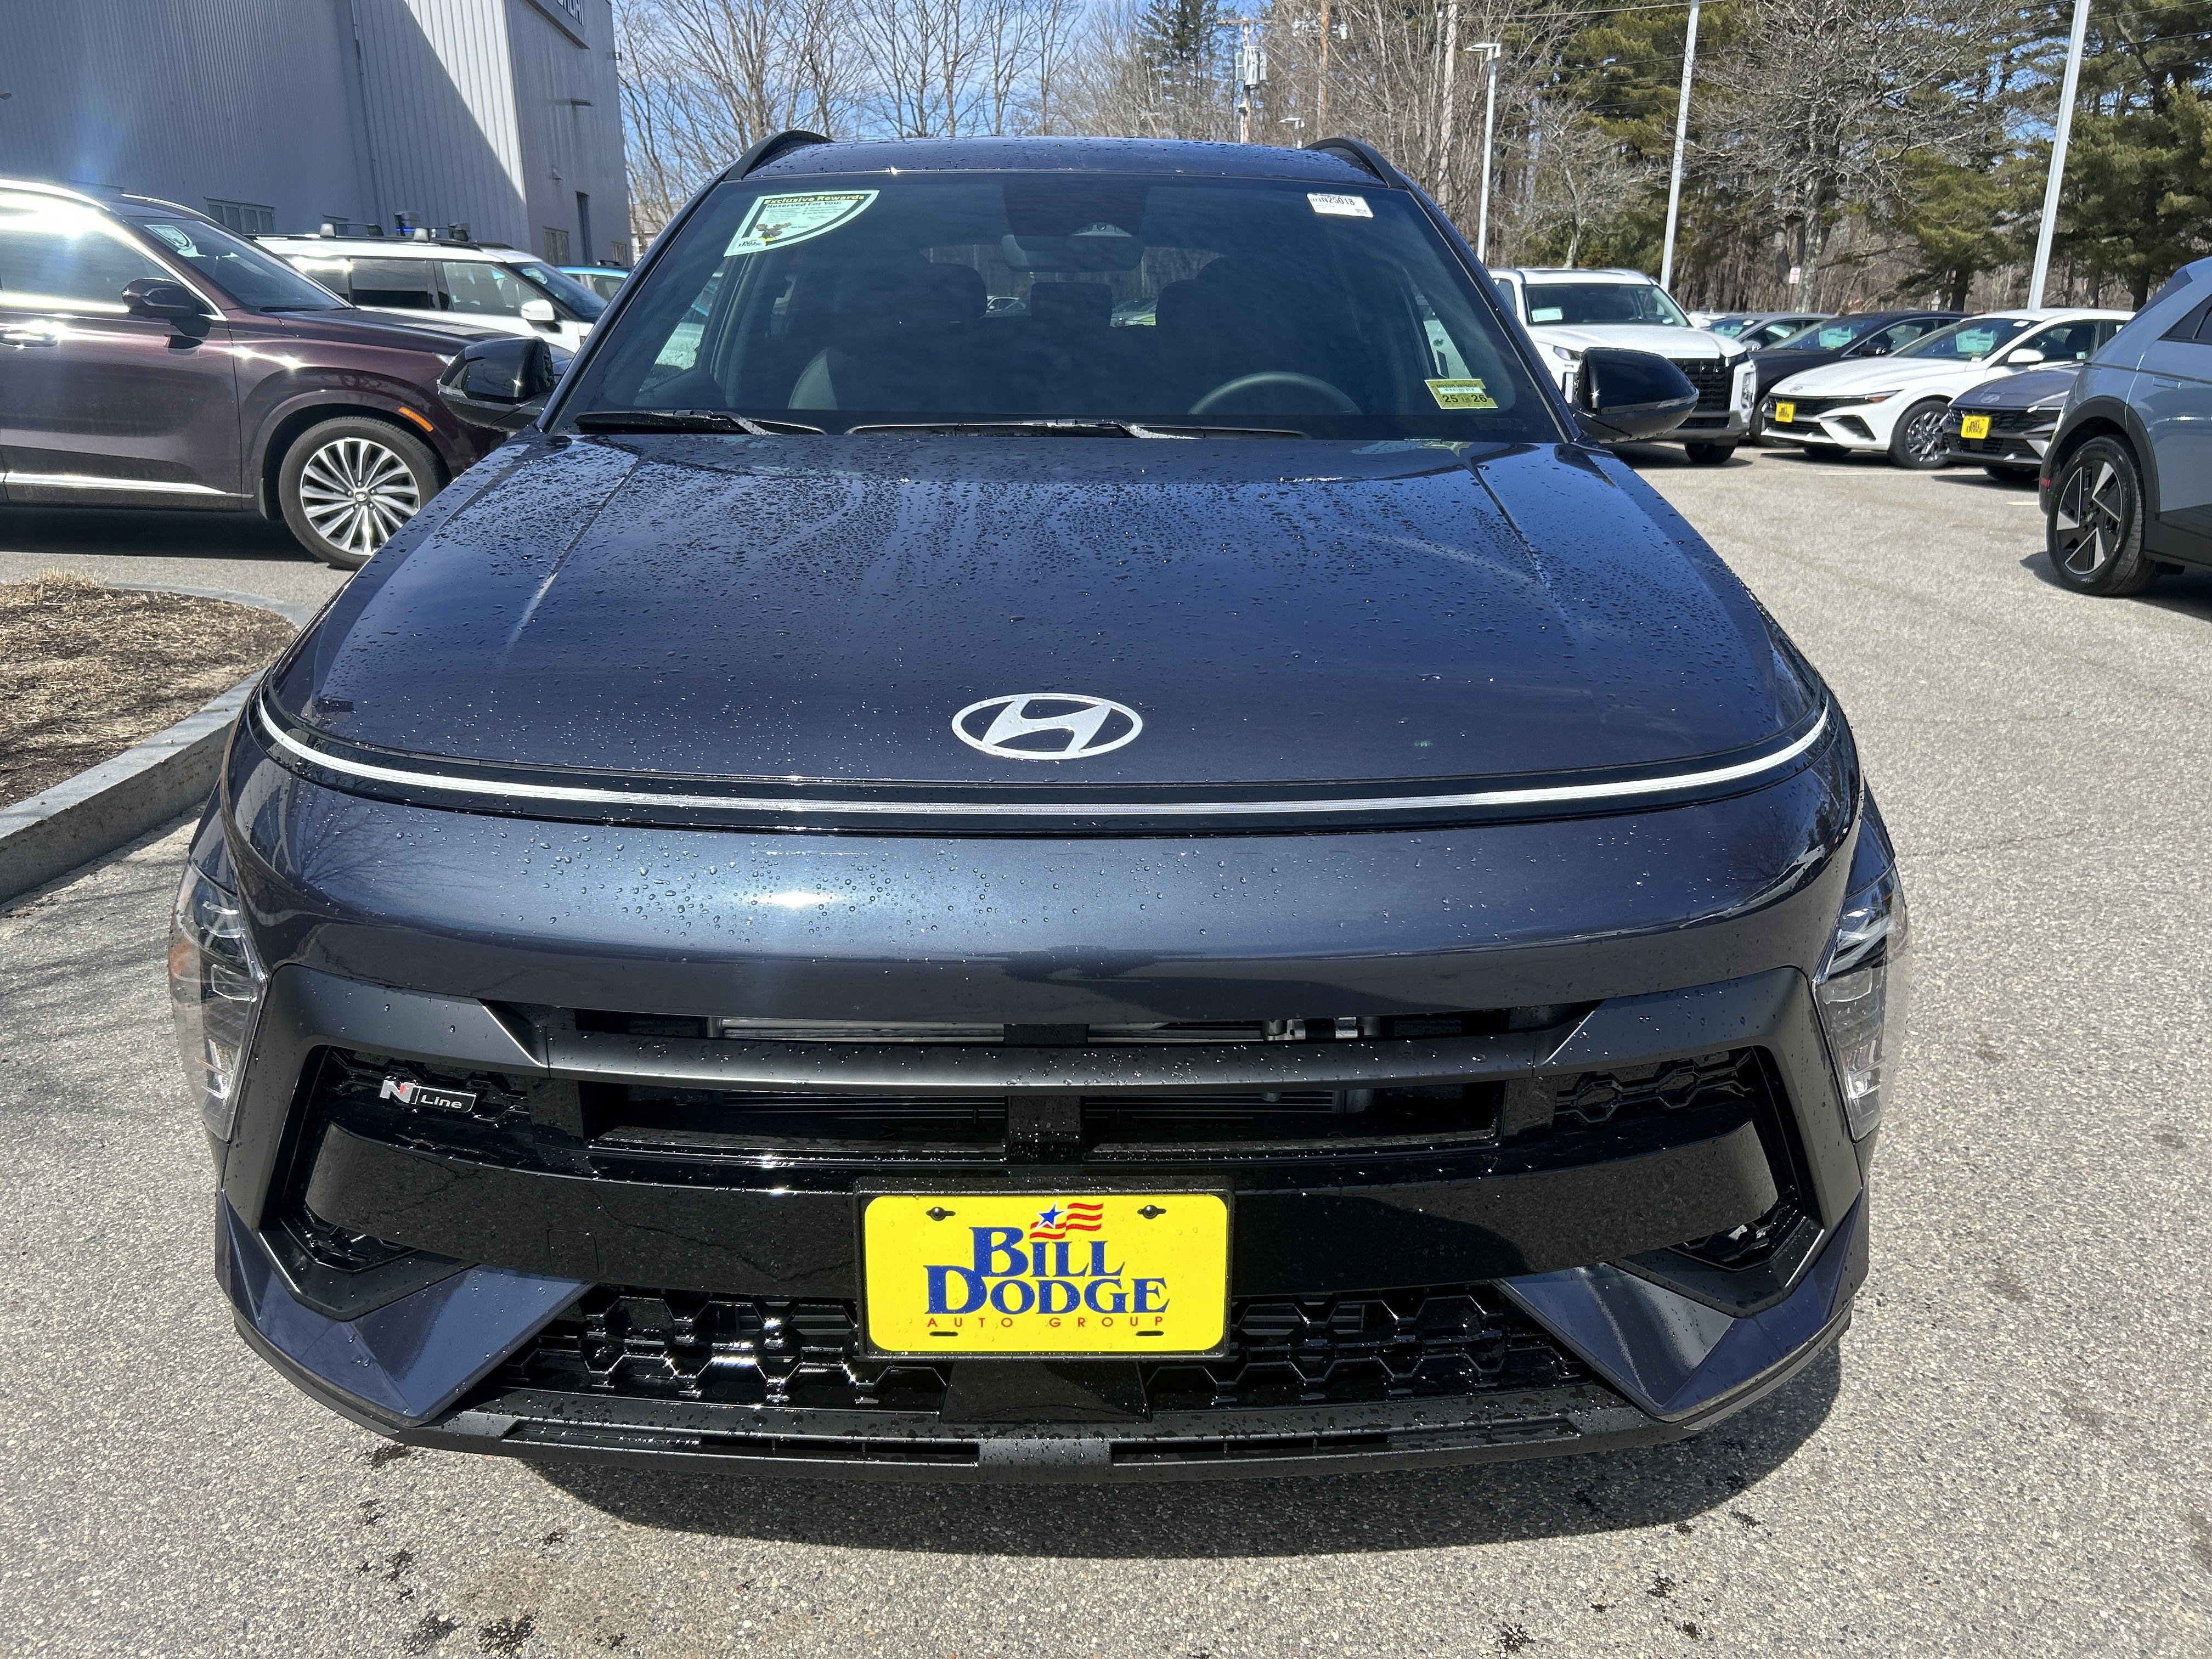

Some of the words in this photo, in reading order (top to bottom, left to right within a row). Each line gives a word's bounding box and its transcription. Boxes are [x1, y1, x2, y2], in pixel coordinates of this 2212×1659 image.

[380, 1079, 415, 1104] N
[421, 1094, 462, 1109] Line
[969, 1226, 1126, 1278] BILL
[923, 1265, 1170, 1314] DODGE
[927, 1317, 1014, 1328] AUTO
[1049, 1316, 1164, 1328] GROUP
